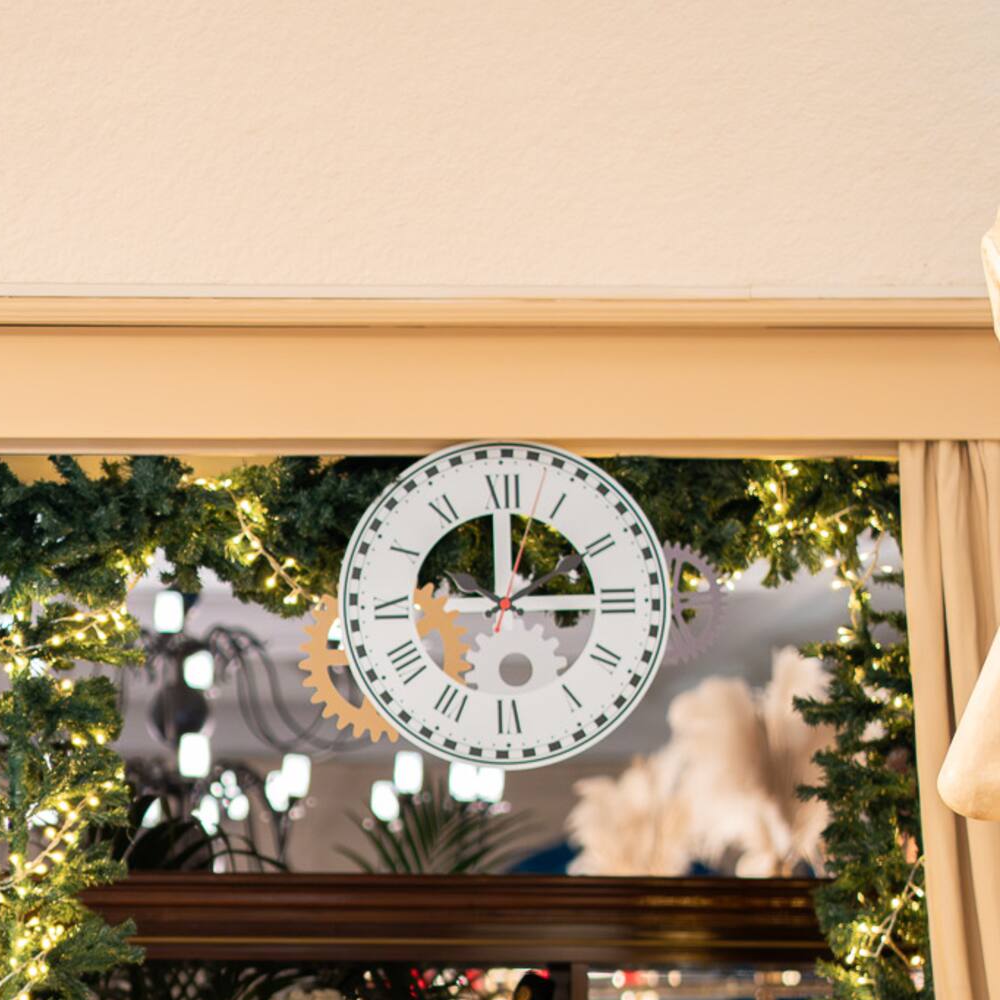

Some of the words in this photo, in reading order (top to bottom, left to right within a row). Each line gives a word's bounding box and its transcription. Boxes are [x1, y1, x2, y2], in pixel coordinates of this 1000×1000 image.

[485, 474, 520, 509] XII
[585, 534, 615, 558] II
[600, 588, 635, 614] III
[497, 699, 522, 734] VI
